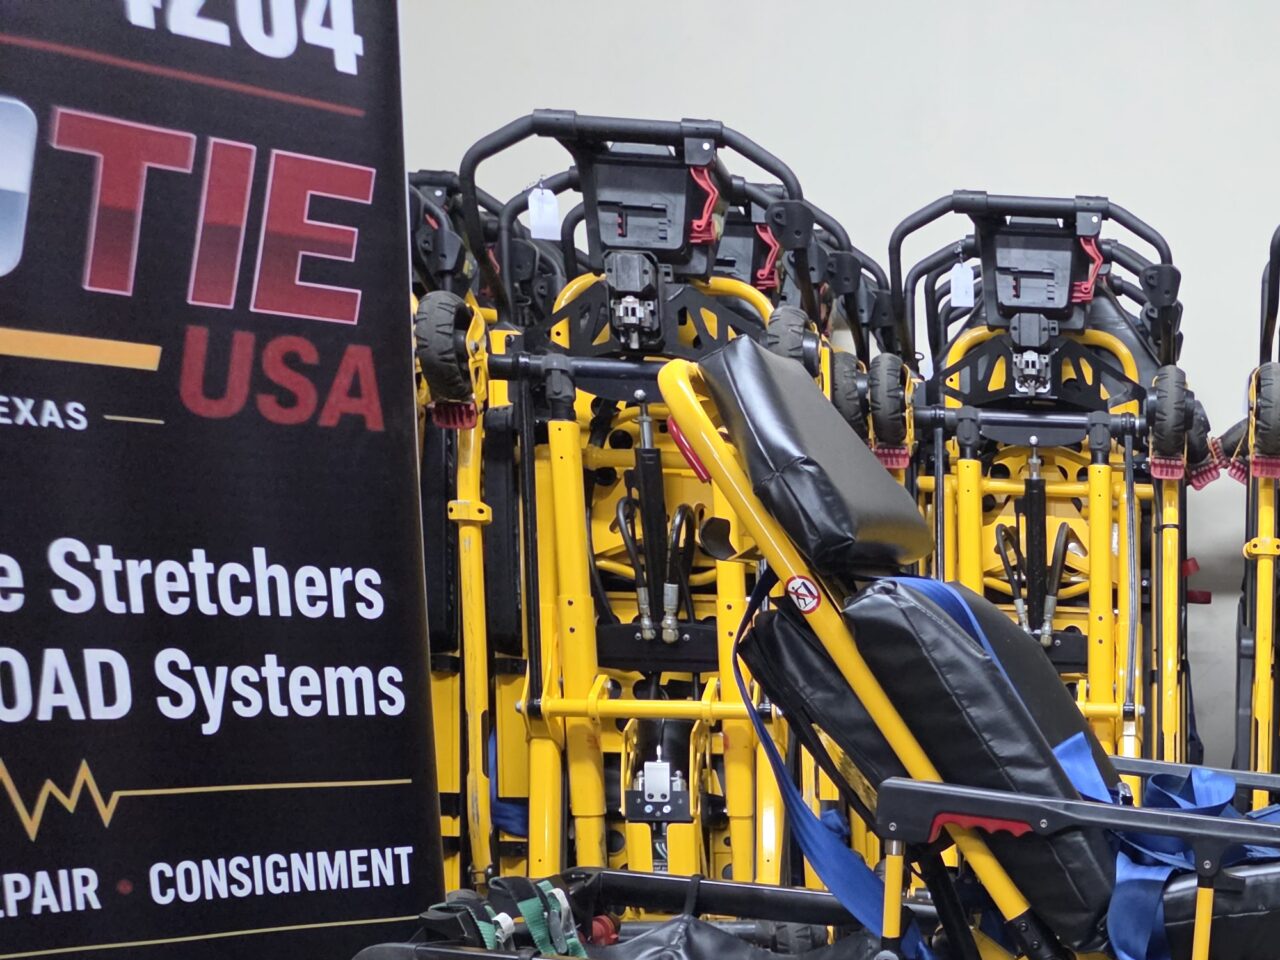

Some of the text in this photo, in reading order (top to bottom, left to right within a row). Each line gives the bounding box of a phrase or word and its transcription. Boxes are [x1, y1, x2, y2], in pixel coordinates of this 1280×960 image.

[127, 0, 363, 76] 204
[179, 325, 385, 432] USA
[47, 537, 385, 620] Stretchers
[154, 647, 406, 735] Systems
[0, 846, 414, 918] PAIR CONSIGNMENT
